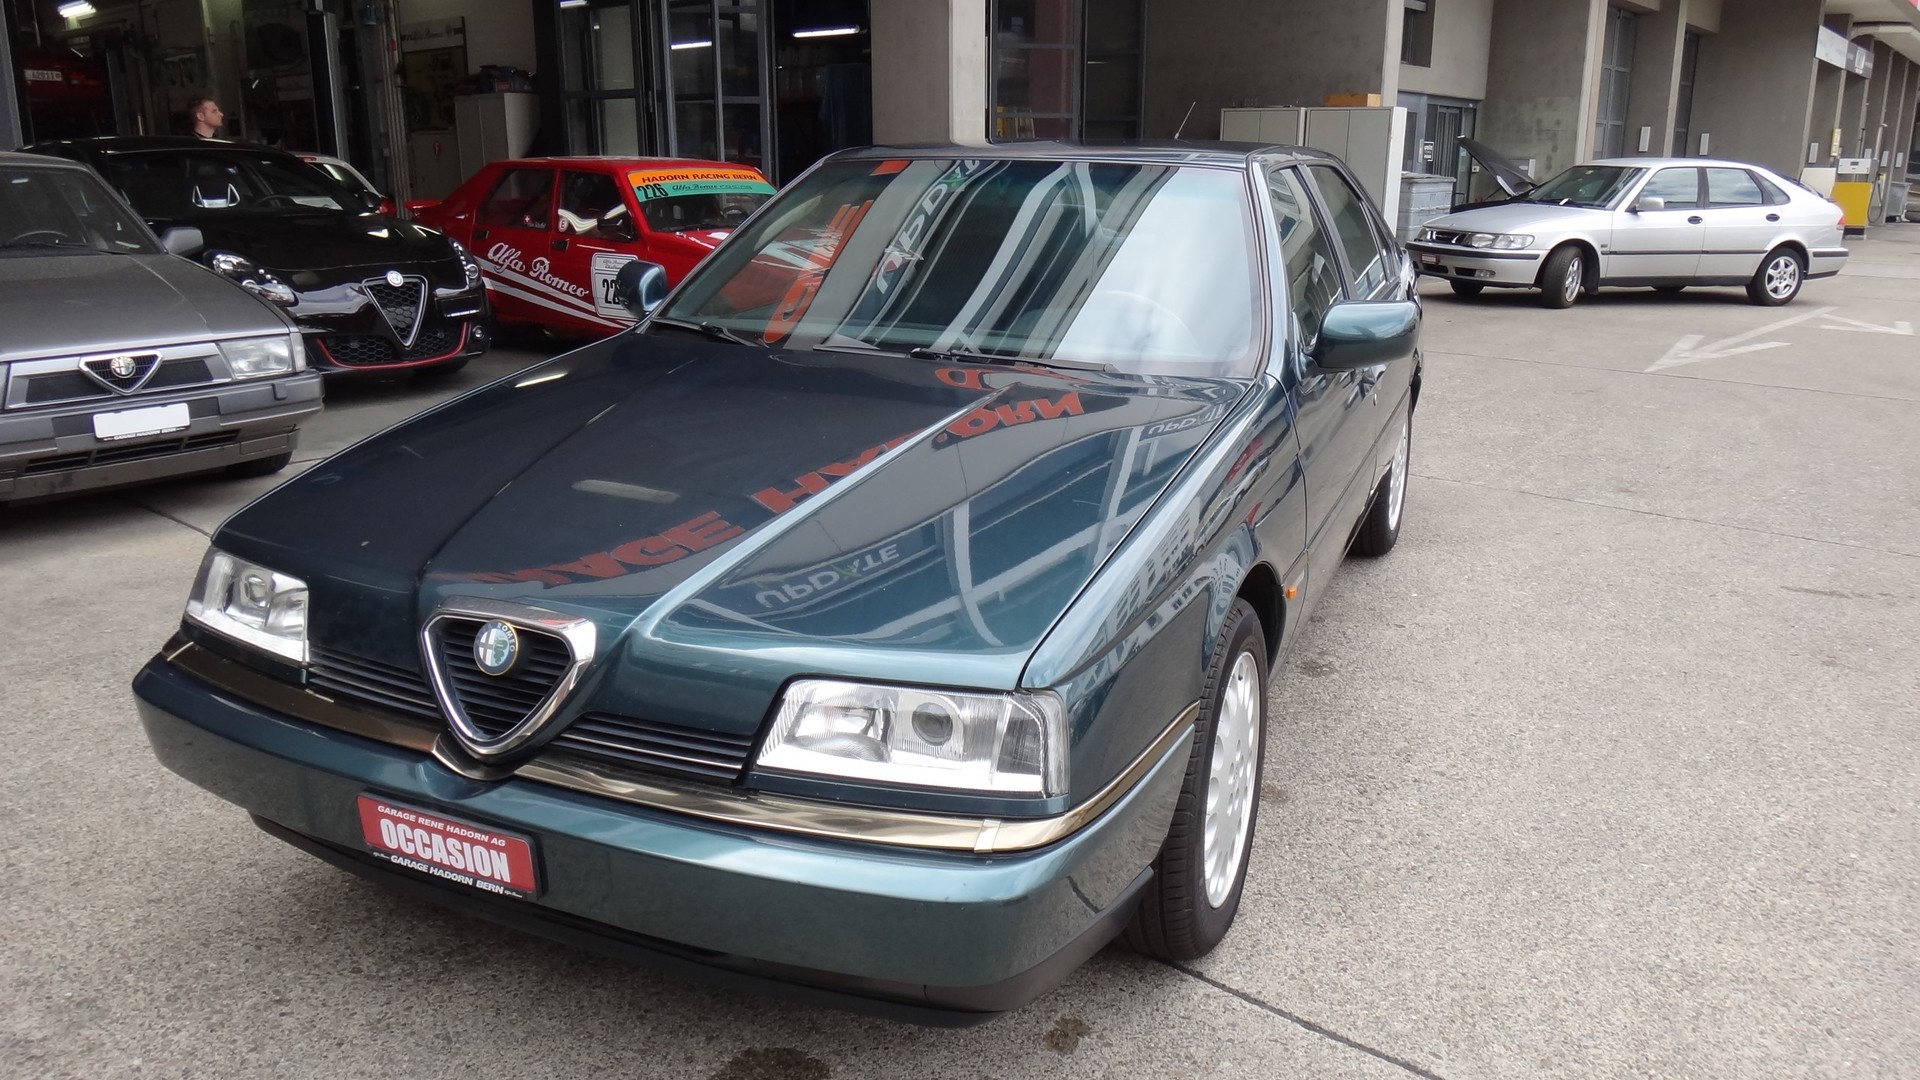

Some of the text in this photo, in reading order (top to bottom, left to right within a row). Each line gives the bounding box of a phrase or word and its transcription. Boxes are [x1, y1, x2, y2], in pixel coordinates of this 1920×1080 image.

[636, 183, 669, 200] 226
[641, 174, 690, 184] HADORN
[733, 173, 757, 181] BERN
[487, 242, 590, 298] Alfa Romeo
[377, 805, 506, 847] GARAGE RENE HADORN AG
[379, 818, 511, 883] OCCASION
[390, 855, 429, 872] GARAGE
[430, 867, 473, 886] HADORN
[475, 880, 504, 895] BERN
